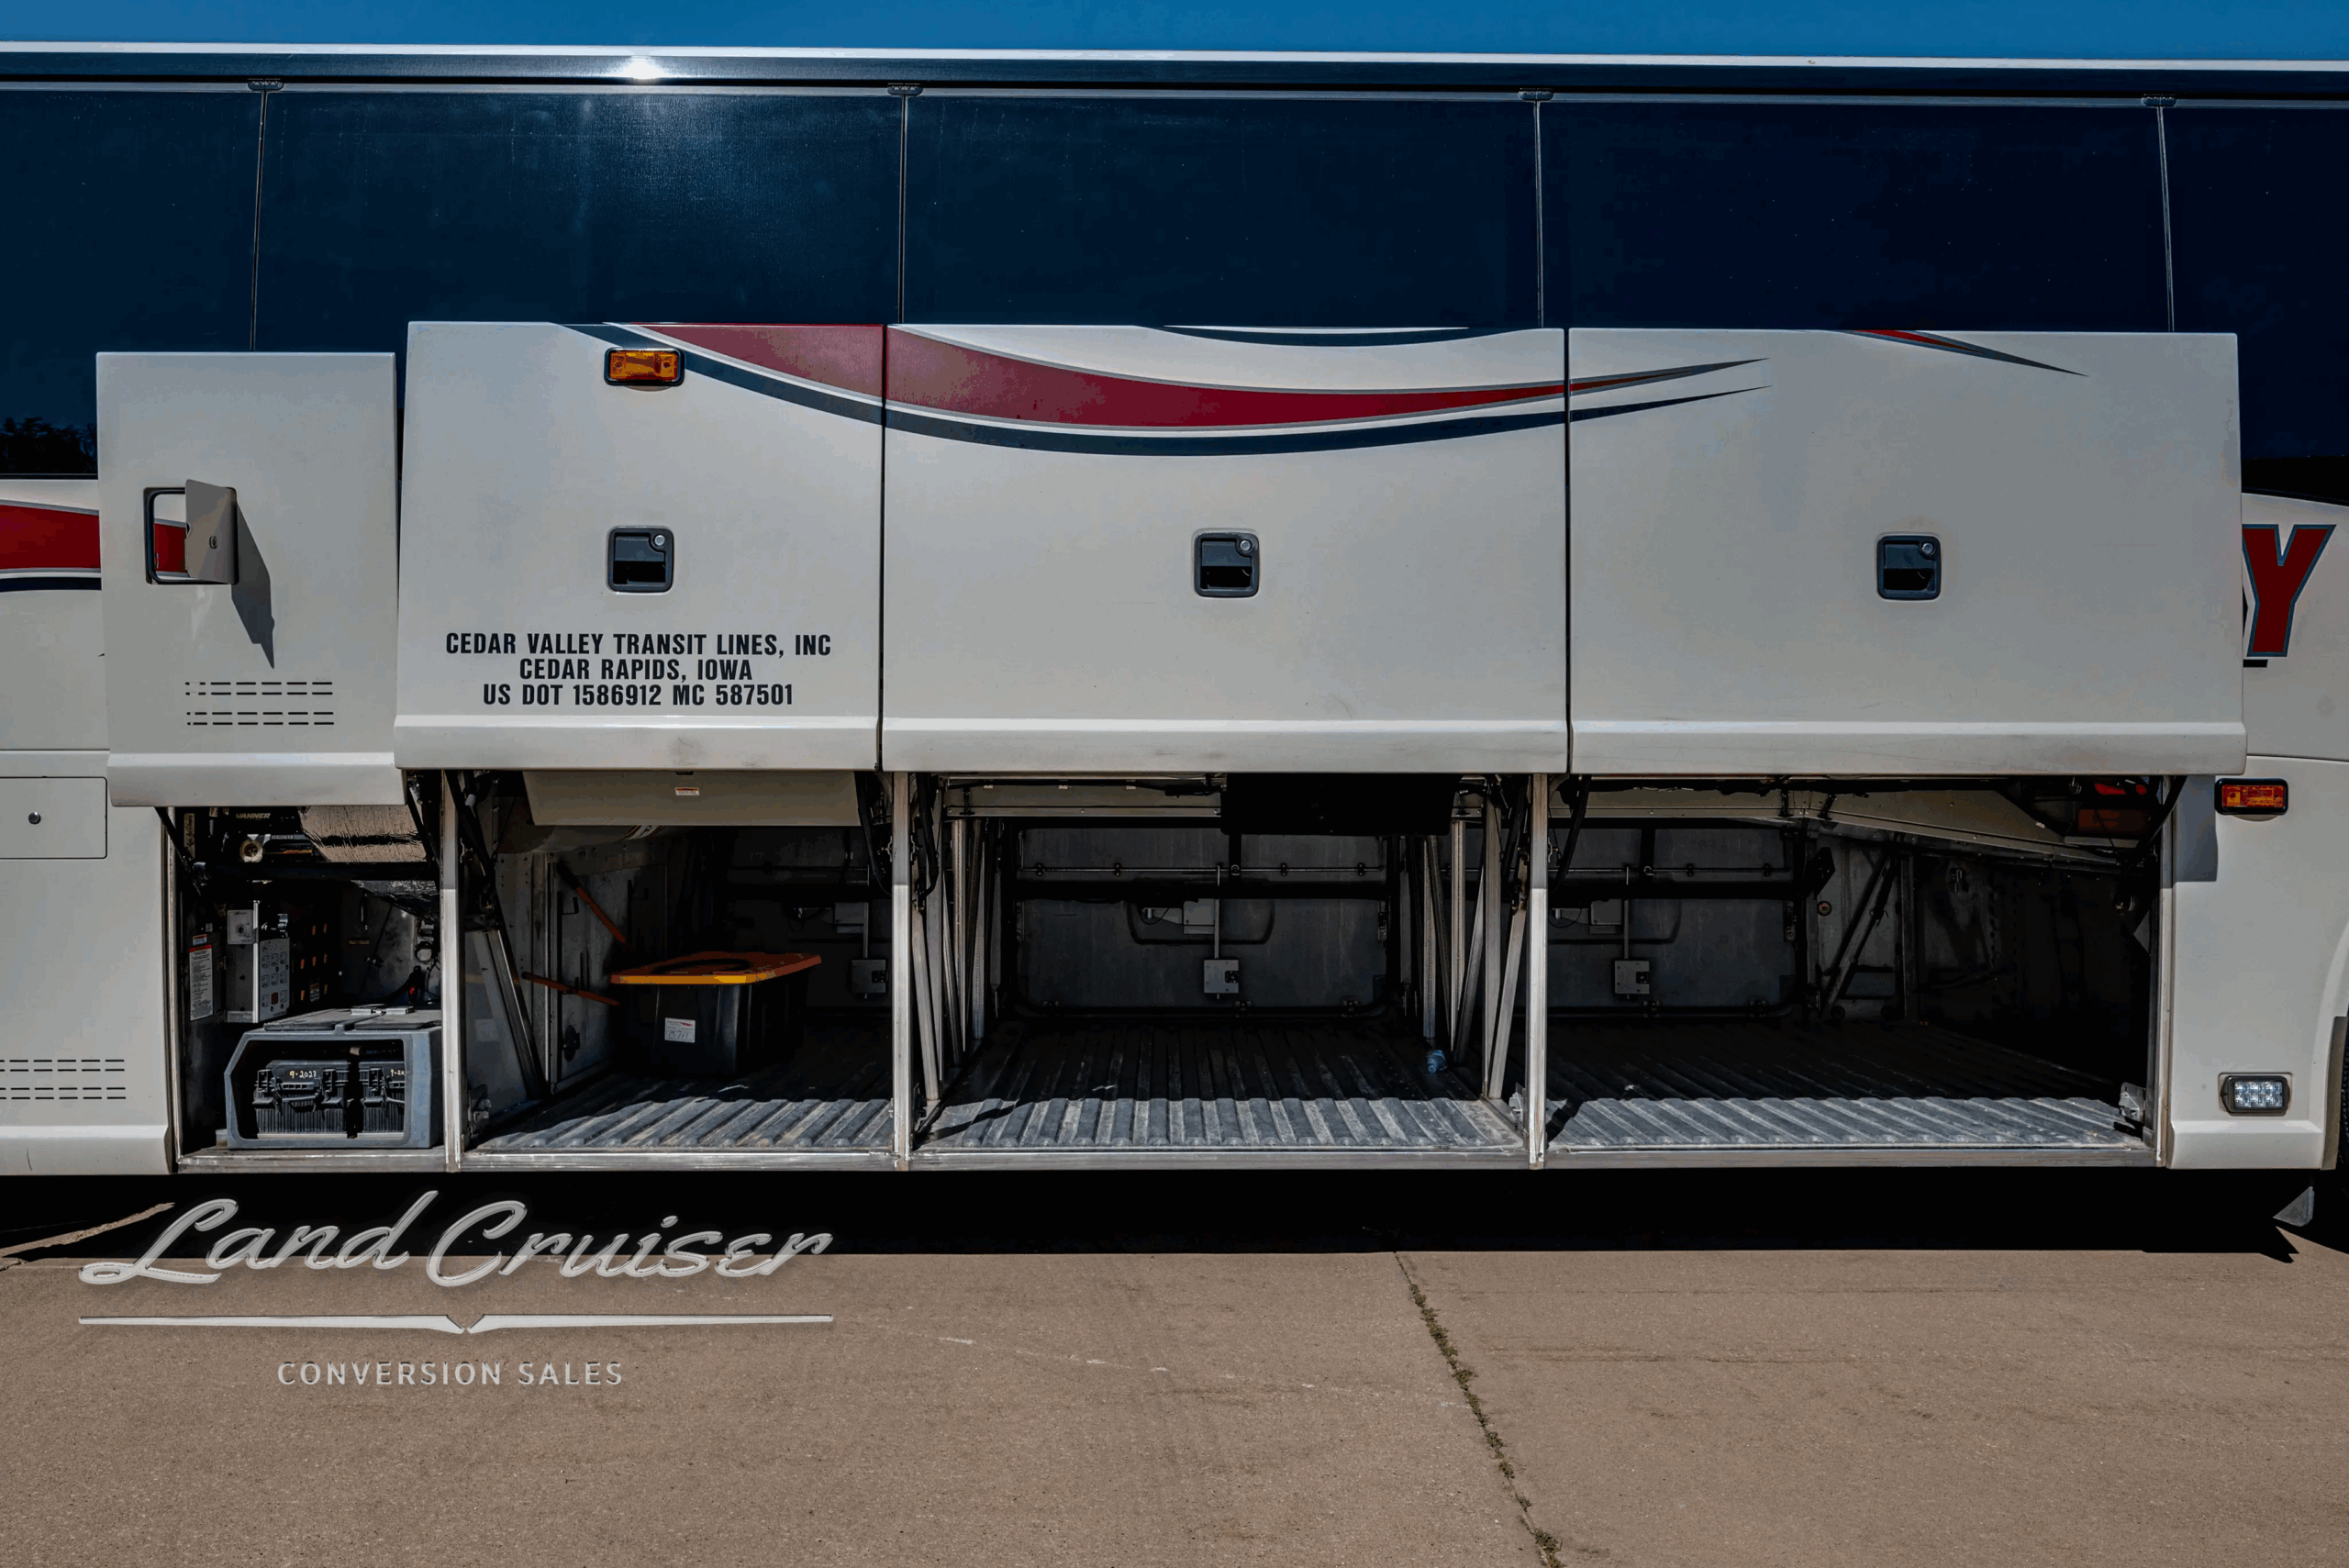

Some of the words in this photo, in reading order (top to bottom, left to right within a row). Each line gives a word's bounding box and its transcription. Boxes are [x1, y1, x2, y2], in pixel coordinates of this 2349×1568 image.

[446, 632, 517, 654] CEDAR
[527, 633, 604, 655] VALLEY
[612, 633, 707, 655] TRANSIT
[717, 634, 784, 659] LINES,
[795, 634, 831, 656] INC
[519, 658, 590, 680] CEDAR
[601, 658, 686, 682] RAPIDS,
[697, 659, 752, 681] IOWA
[483, 684, 511, 706] US
[522, 684, 563, 706] DOT
[573, 684, 662, 706] 1586912
[673, 684, 705, 706] MC
[716, 684, 793, 706] 587501
